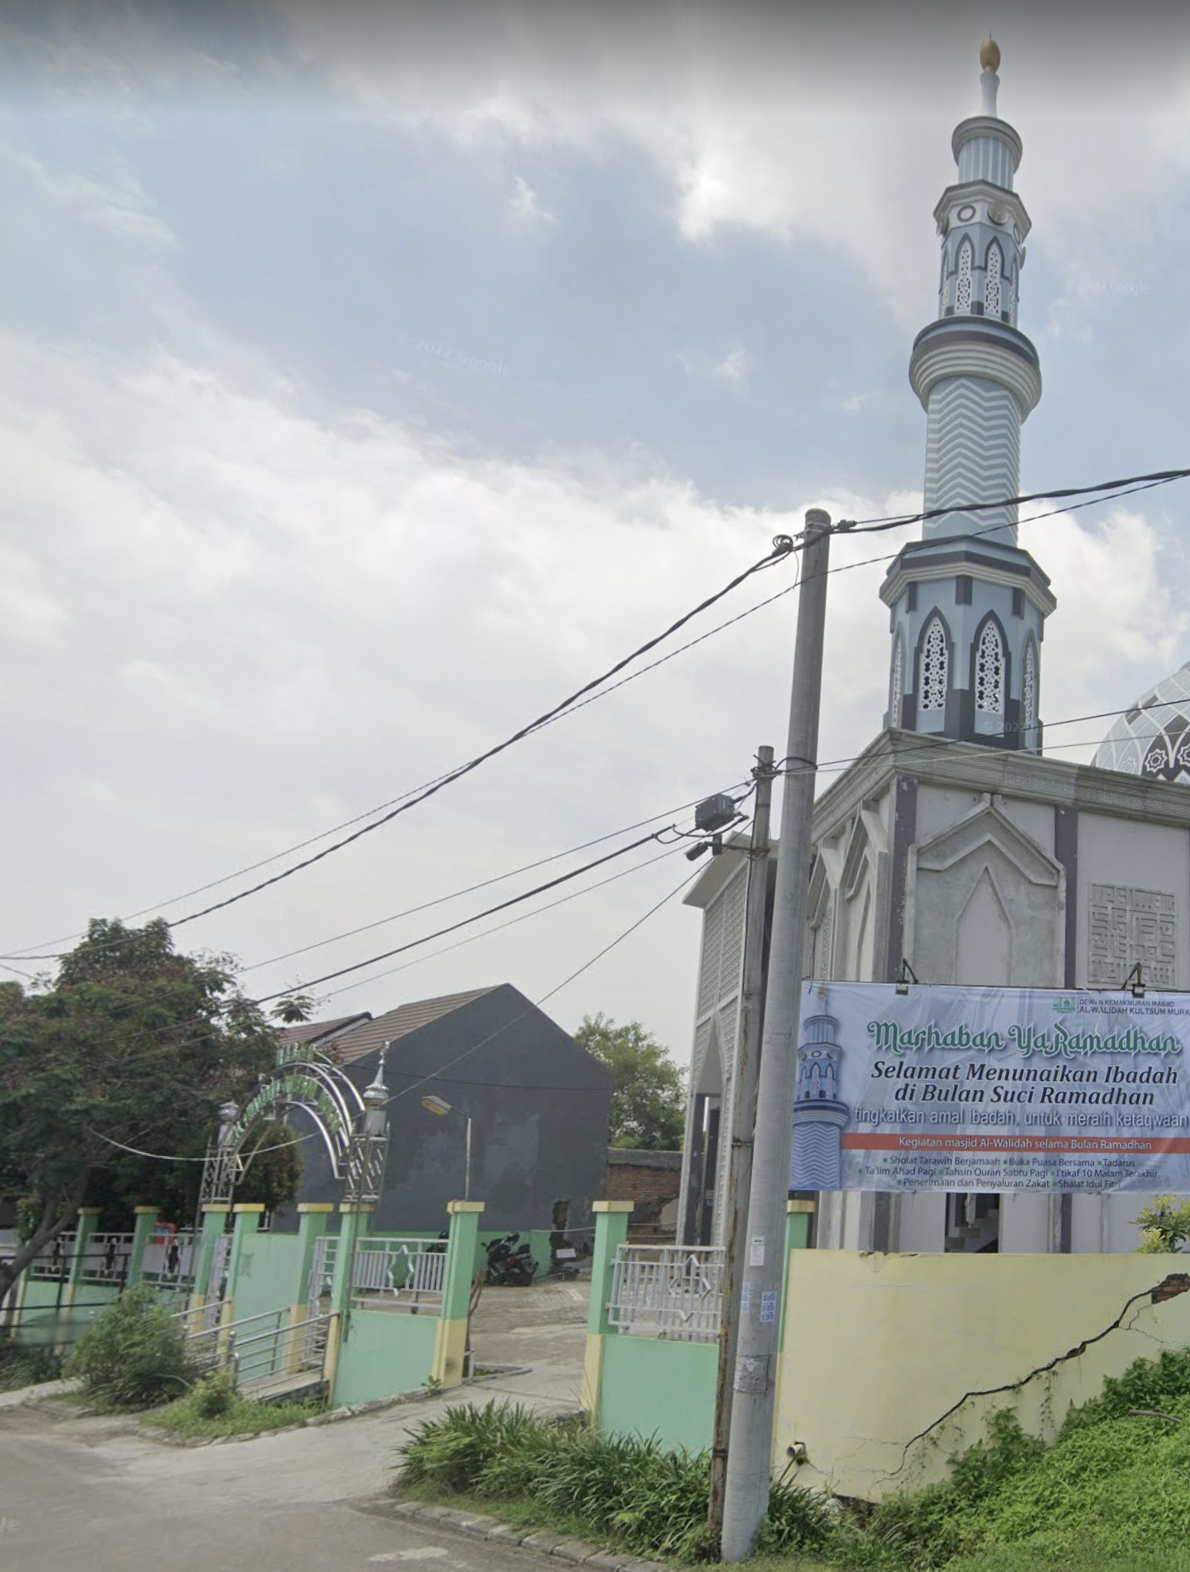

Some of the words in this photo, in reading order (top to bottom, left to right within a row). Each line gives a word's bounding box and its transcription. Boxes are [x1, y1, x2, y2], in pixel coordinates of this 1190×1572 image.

[1079, 1006, 1128, 1015] AL-WALIDAH
[1129, 1007, 1166, 1016] KULTSUM
[867, 1020, 1006, 1054] Marhaban
[1007, 1021, 1049, 1058] Ya
[1043, 1019, 1181, 1059] Ramadhan
[871, 1060, 961, 1081] Selamat
[965, 1063, 1098, 1083] Menunaikan
[1104, 1065, 1178, 1084] Ibadah
[894, 1083, 916, 1101] di
[921, 1084, 985, 1103] Bulan
[990, 1085, 1035, 1104] Suci
[1040, 1086, 1155, 1106] Ramadhan
[854, 1108, 925, 1126] tingkatkan
[929, 1109, 965, 1124] amal
[969, 1110, 1019, 1126] ibadah,
[1024, 1111, 1061, 1126] untuk
[1065, 1111, 1111, 1127] meraih
[1116, 1112, 1188, 1130] ketaqwaan
[899, 1137, 943, 1149] Kegiatan
[945, 1137, 977, 1149] masjid
[979, 1138, 1032, 1149] Al-Walidah
[1034, 1139, 1069, 1149] selama
[1070, 1139, 1098, 1149] Bulan
[1100, 1139, 1152, 1150] Ramadhan
[889, 1156, 918, 1165] Sholat
[919, 1156, 952, 1165] Tarawih
[954, 1157, 1001, 1167] Berjamaah
[1009, 1158, 1030, 1166] Buka
[1032, 1158, 1057, 1167] Puasa
[1058, 1158, 1095, 1167] Bersama
[1102, 1159, 1136, 1167] Tadarus
[892, 1167, 916, 1175] Ahad
[917, 1167, 937, 1177] Pagi
[944, 1167, 973, 1176] Tahsin
[974, 1168, 1001, 1177] Quran
[1003, 1169, 1028, 1177] Sabtu
[1030, 1169, 1049, 1179] Pagi
[1082, 1170, 1092, 1178] 10
[1094, 1169, 1122, 1178] Malam
[1124, 1170, 1158, 1178] Terakhir
[903, 1178, 955, 1187] Penerimaan
[957, 1178, 974, 1187] dan
[976, 1179, 1024, 1189] Penyaluran
[1026, 1179, 1050, 1188] Zakat
[1086, 1180, 1103, 1188] Idul
